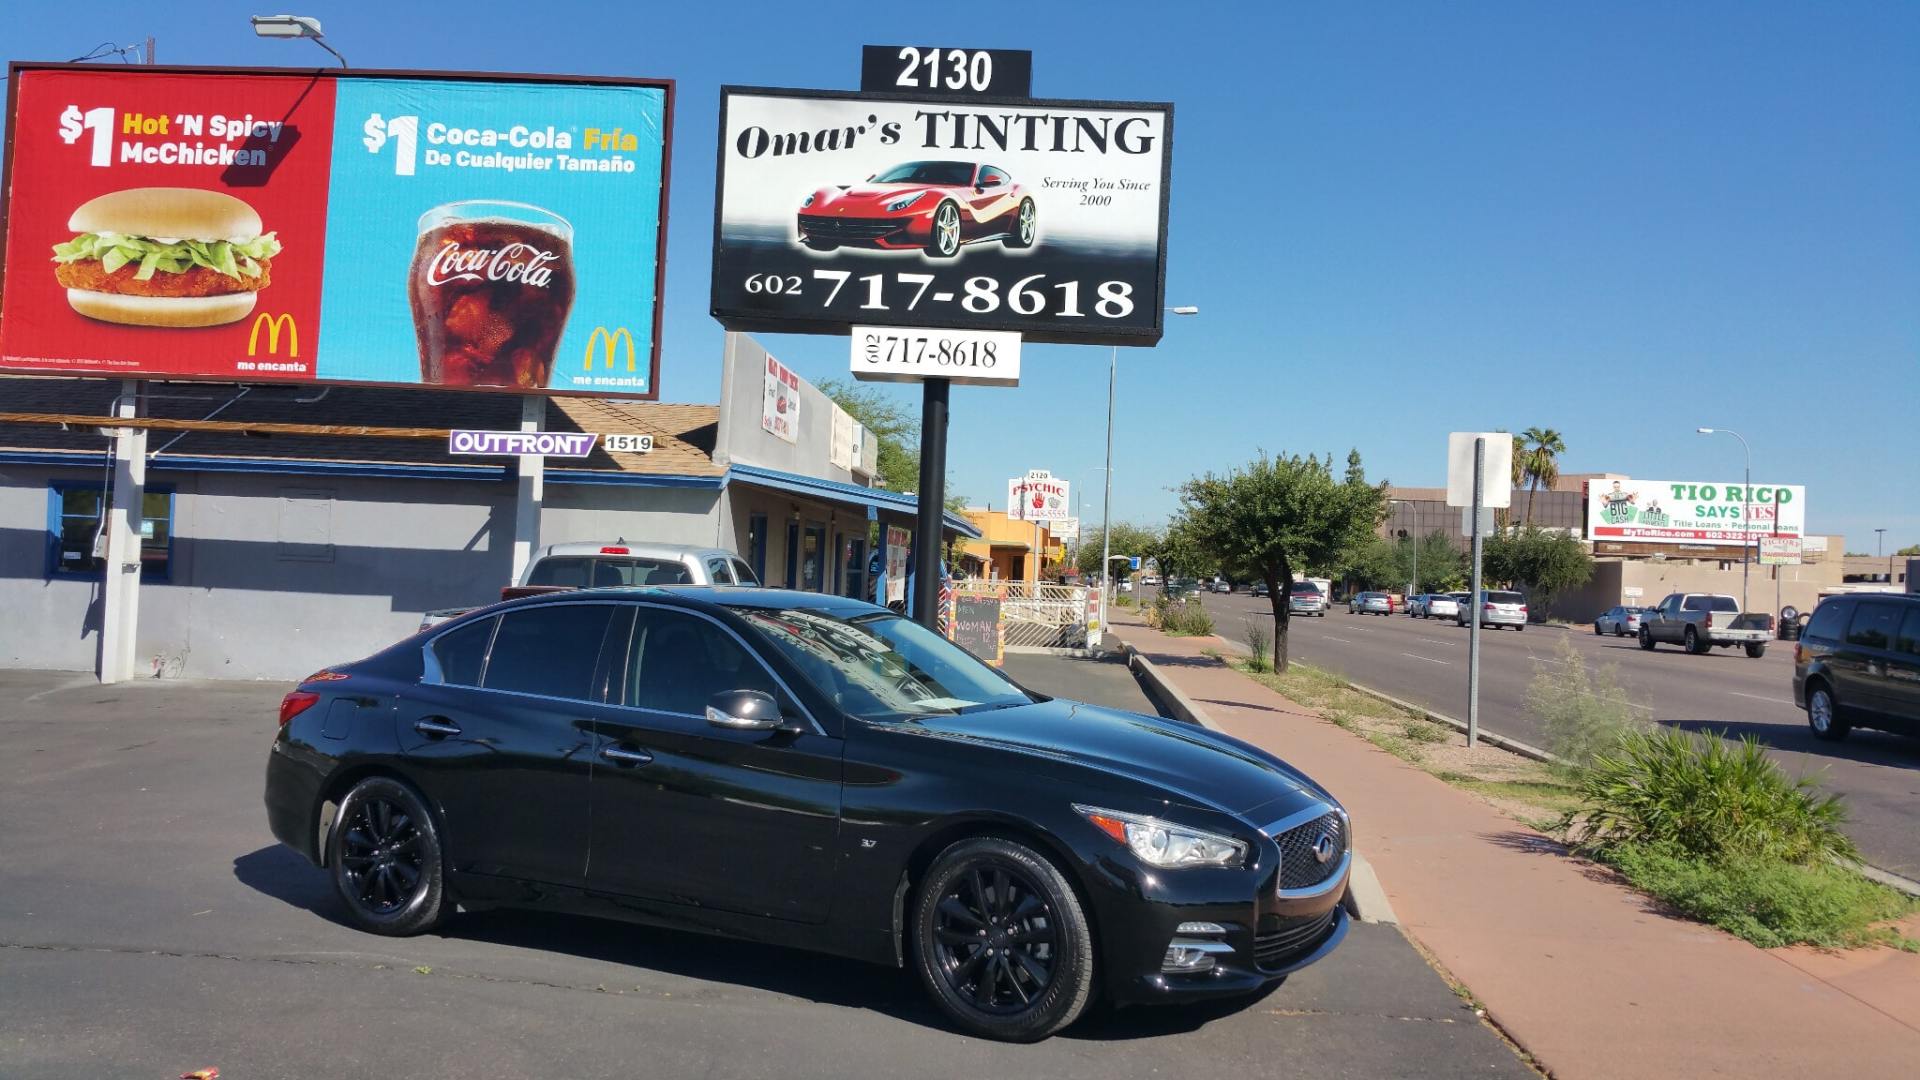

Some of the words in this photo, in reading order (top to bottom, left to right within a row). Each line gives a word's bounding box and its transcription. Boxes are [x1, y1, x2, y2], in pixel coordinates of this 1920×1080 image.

[896, 47, 992, 91] 2130
[58, 105, 115, 167] $1
[123, 113, 170, 135] Hot
[209, 114, 283, 141] Spicy
[736, 114, 902, 159] Omar's
[915, 110, 1156, 155] TINTING
[362, 113, 419, 176] $1
[426, 122, 572, 149] Coca-Cola
[583, 127, 638, 151] Fría
[120, 142, 267, 166] McChicken
[425, 149, 451, 166] De
[456, 150, 552, 172] Cualquier
[557, 154, 636, 173] Tamaño
[1041, 176, 1089, 192] Serving
[1092, 178, 1116, 191] You
[1118, 178, 1151, 191] Since
[1079, 194, 1112, 208] 2000
[426, 242, 560, 289] Coca-Cola
[744, 273, 803, 296] 602
[812, 269, 1135, 318] 717-8618
[865, 334, 881, 365] 602
[884, 336, 998, 369] 717-8618
[237, 361, 255, 371] me
[257, 362, 306, 372] encanta
[573, 376, 592, 385] me
[594, 376, 645, 387] encanta
[455, 432, 589, 453] OUTFRONT
[606, 436, 651, 450] 1519
[1012, 482, 1065, 498] PSYCHIC
[1670, 484, 1717, 501] TIO
[1725, 486, 1793, 504] RICO
[1610, 501, 1629, 517] BIG
[1695, 505, 1740, 518] SAYS
[1745, 507, 1775, 519] YES
[1610, 516, 1630, 525] CASH
[1673, 520, 1693, 528] Title
[1695, 521, 1722, 529] Loans
[1731, 523, 1770, 531] Personal
[1623, 528, 1695, 539] MyTioRico.com
[956, 620, 992, 633] WOMAN
